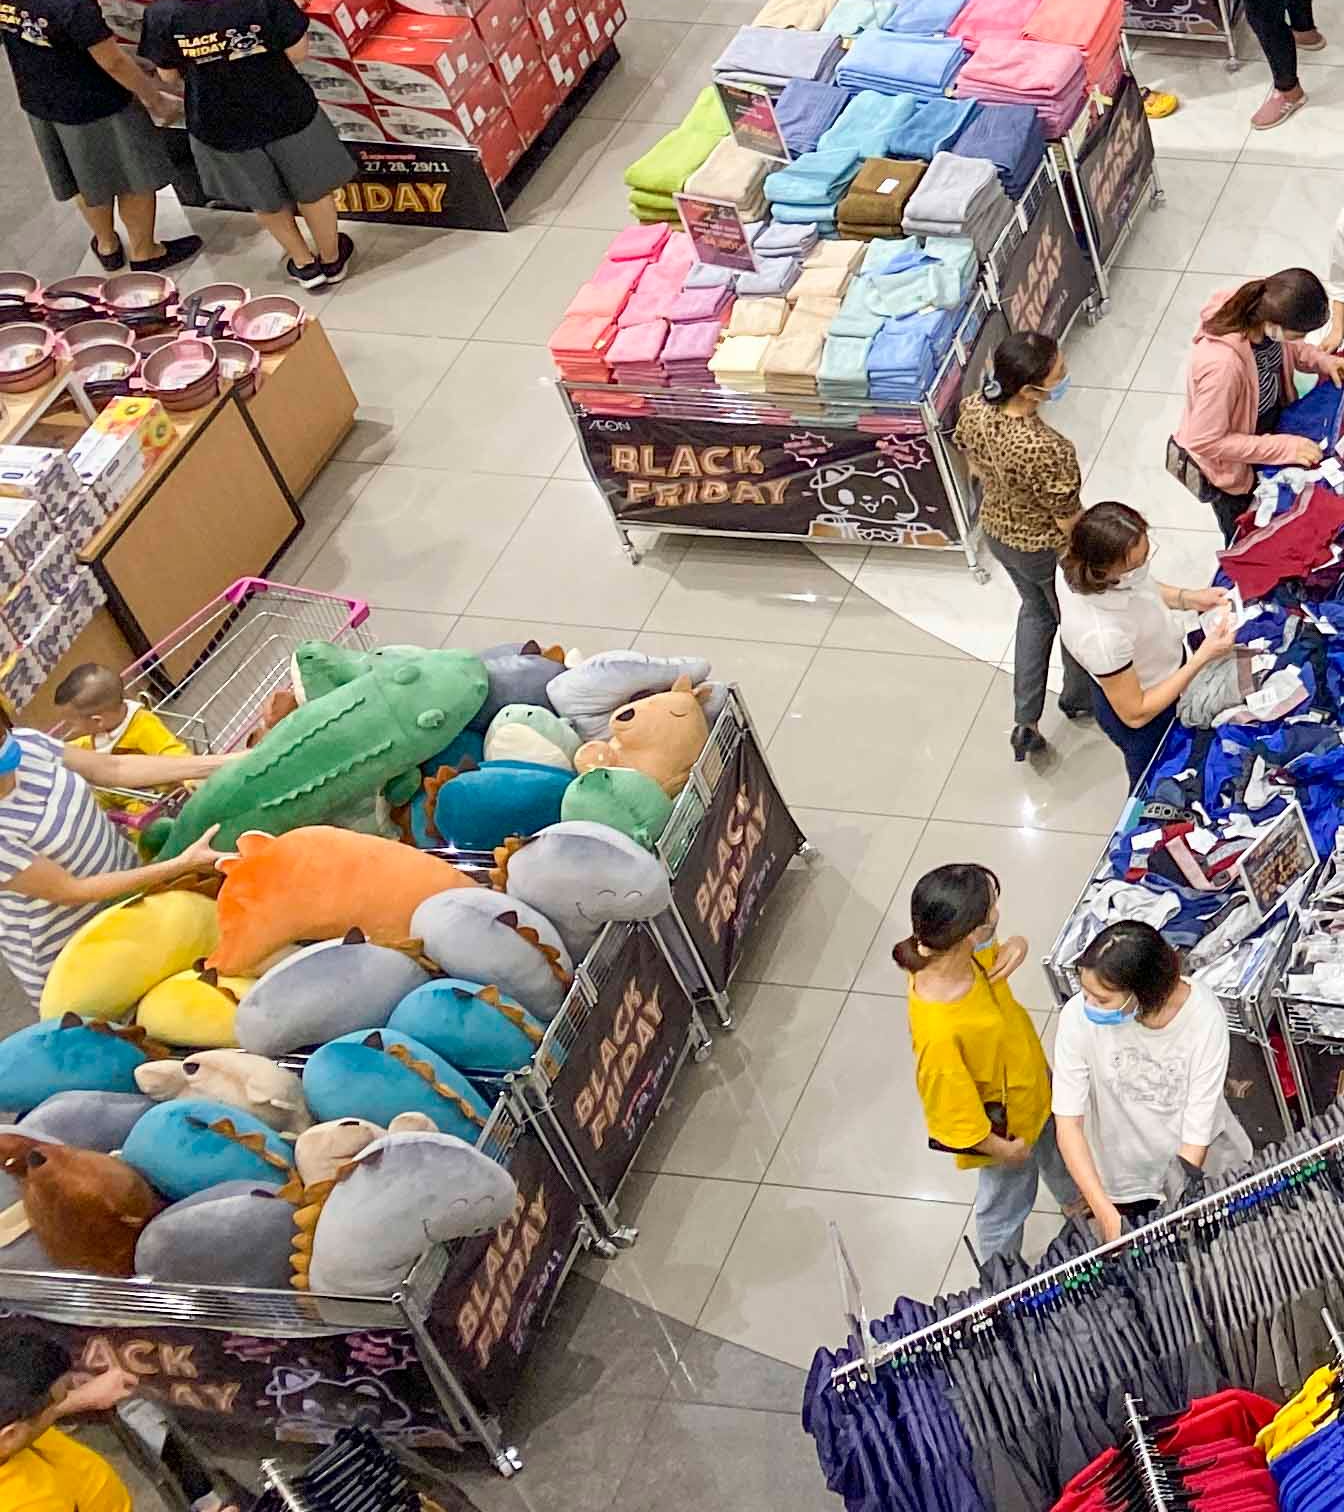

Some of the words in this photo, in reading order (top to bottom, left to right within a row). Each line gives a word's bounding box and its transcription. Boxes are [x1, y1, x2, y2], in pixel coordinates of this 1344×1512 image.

[177, 31, 219, 51] BLACK
[182, 38, 228, 60] FRIDAY
[330, 182, 447, 214] RIDAY
[610, 443, 765, 477] BLACK
[625, 478, 792, 508] FRIDAY
[575, 974, 643, 1127] BLACK
[591, 984, 664, 1149] FRIDAY
